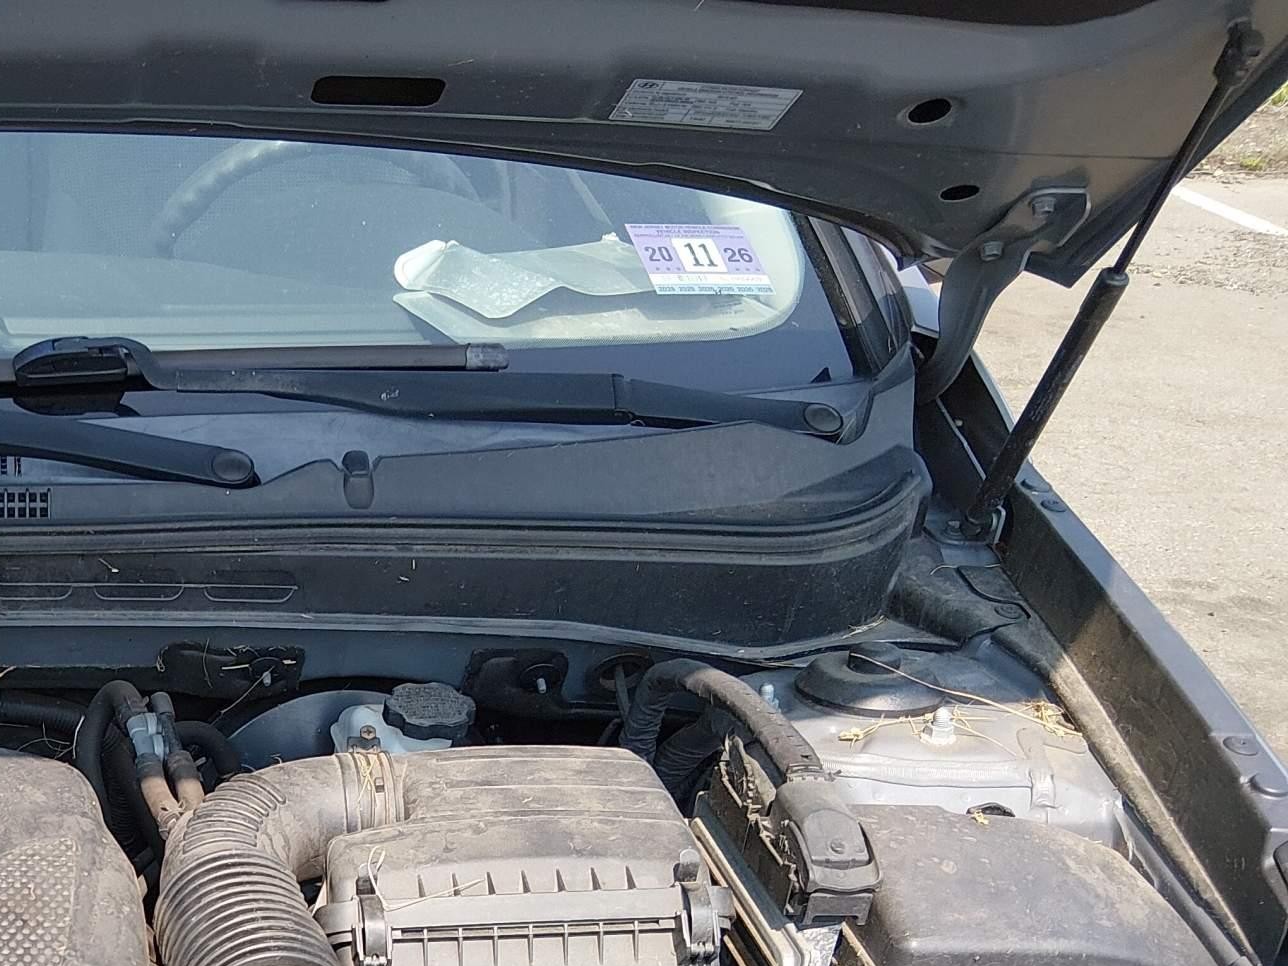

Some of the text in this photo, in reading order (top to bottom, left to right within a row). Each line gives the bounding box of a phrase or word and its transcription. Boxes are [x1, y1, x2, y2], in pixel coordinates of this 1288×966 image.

[644, 242, 753, 267] 20 11 26
